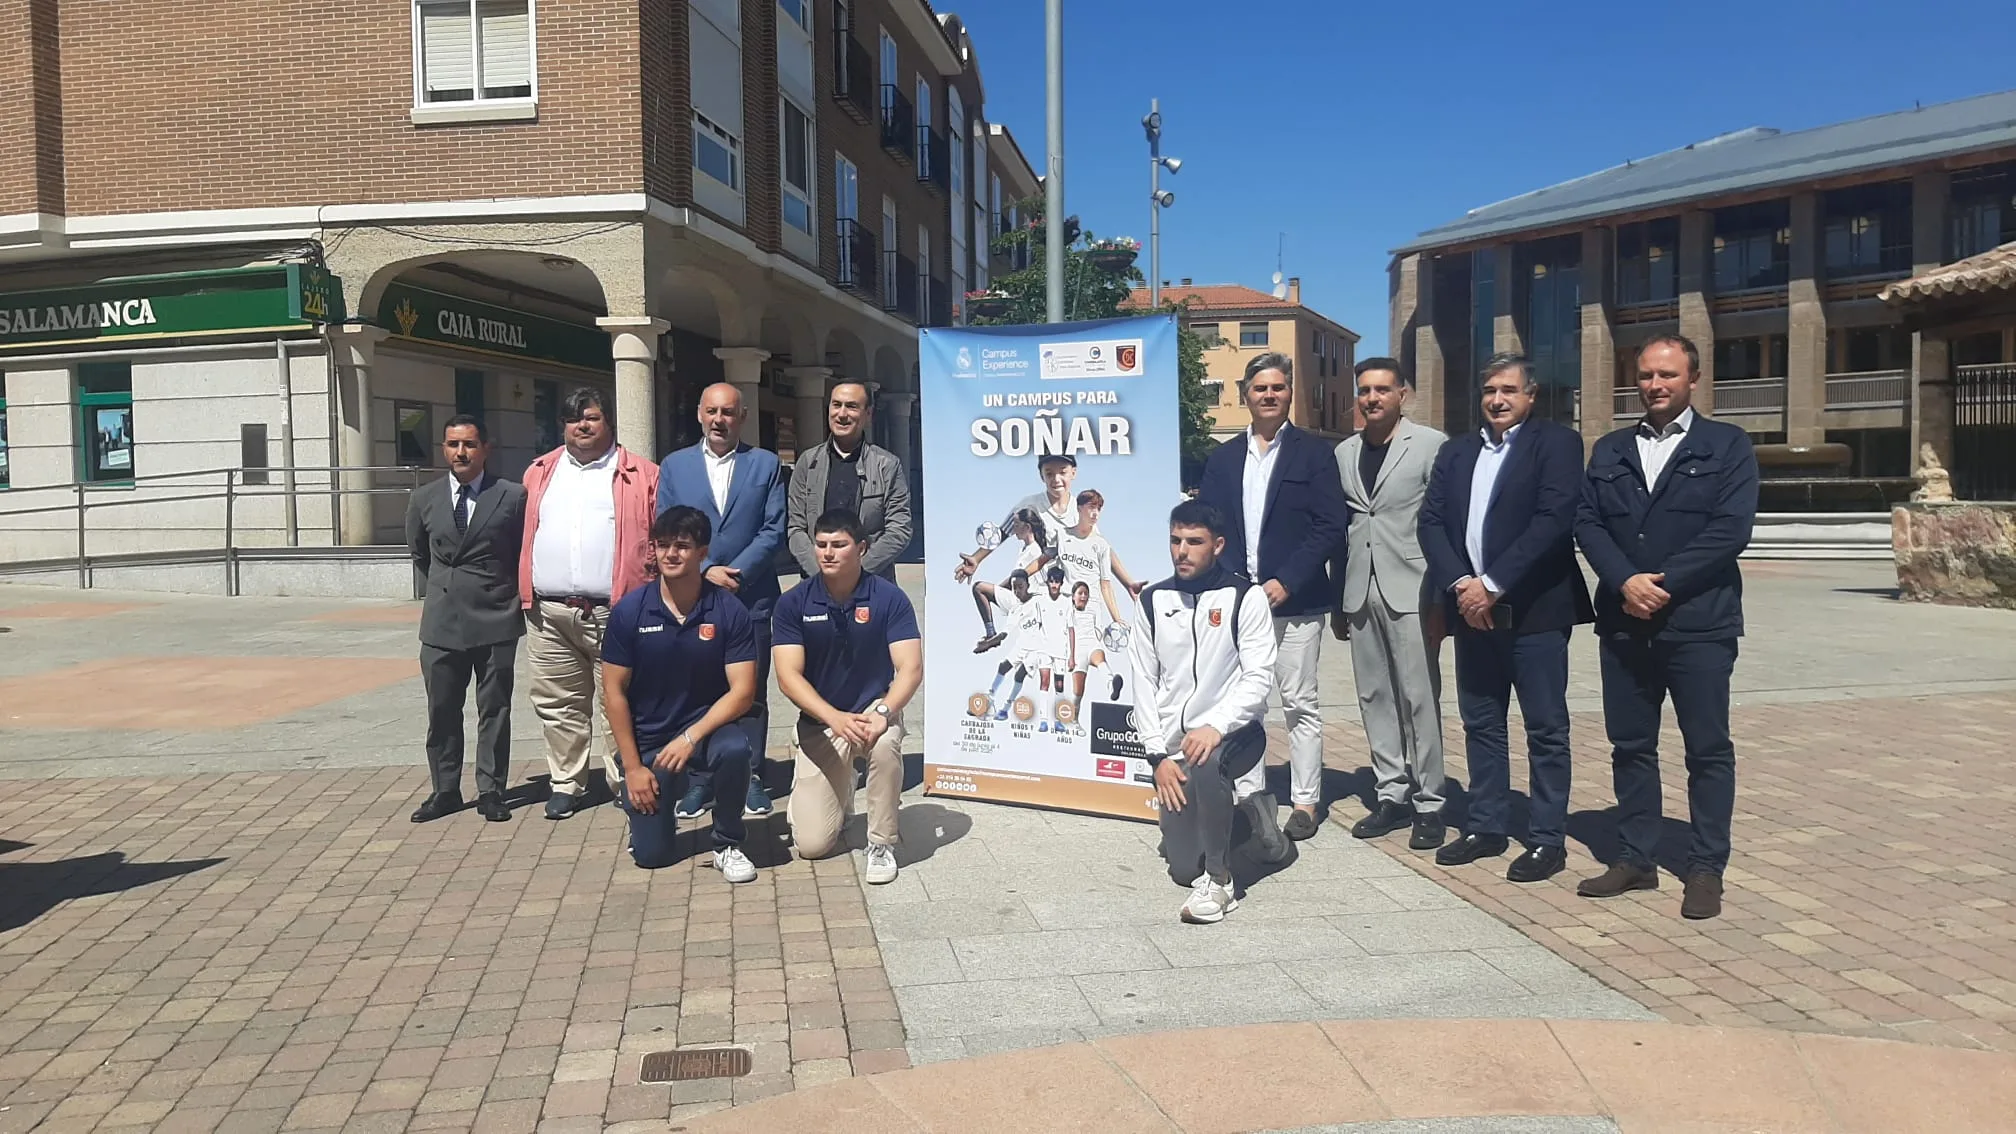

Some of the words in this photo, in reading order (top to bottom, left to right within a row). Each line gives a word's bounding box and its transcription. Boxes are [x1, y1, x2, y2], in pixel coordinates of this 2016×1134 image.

[304, 291, 328, 317] 24h
[0, 298, 157, 335] SALAMANCA
[437, 310, 475, 339] CAJA
[477, 318, 527, 348] RURAL
[982, 348, 1017, 360] Campus
[982, 359, 1029, 371] Experience
[983, 394, 1003, 407] UN
[1007, 391, 1072, 407] CAMPUS
[1077, 390, 1118, 404] PARA
[970, 408, 1132, 457] SOÑAR
[1061, 553, 1094, 569] adidas
